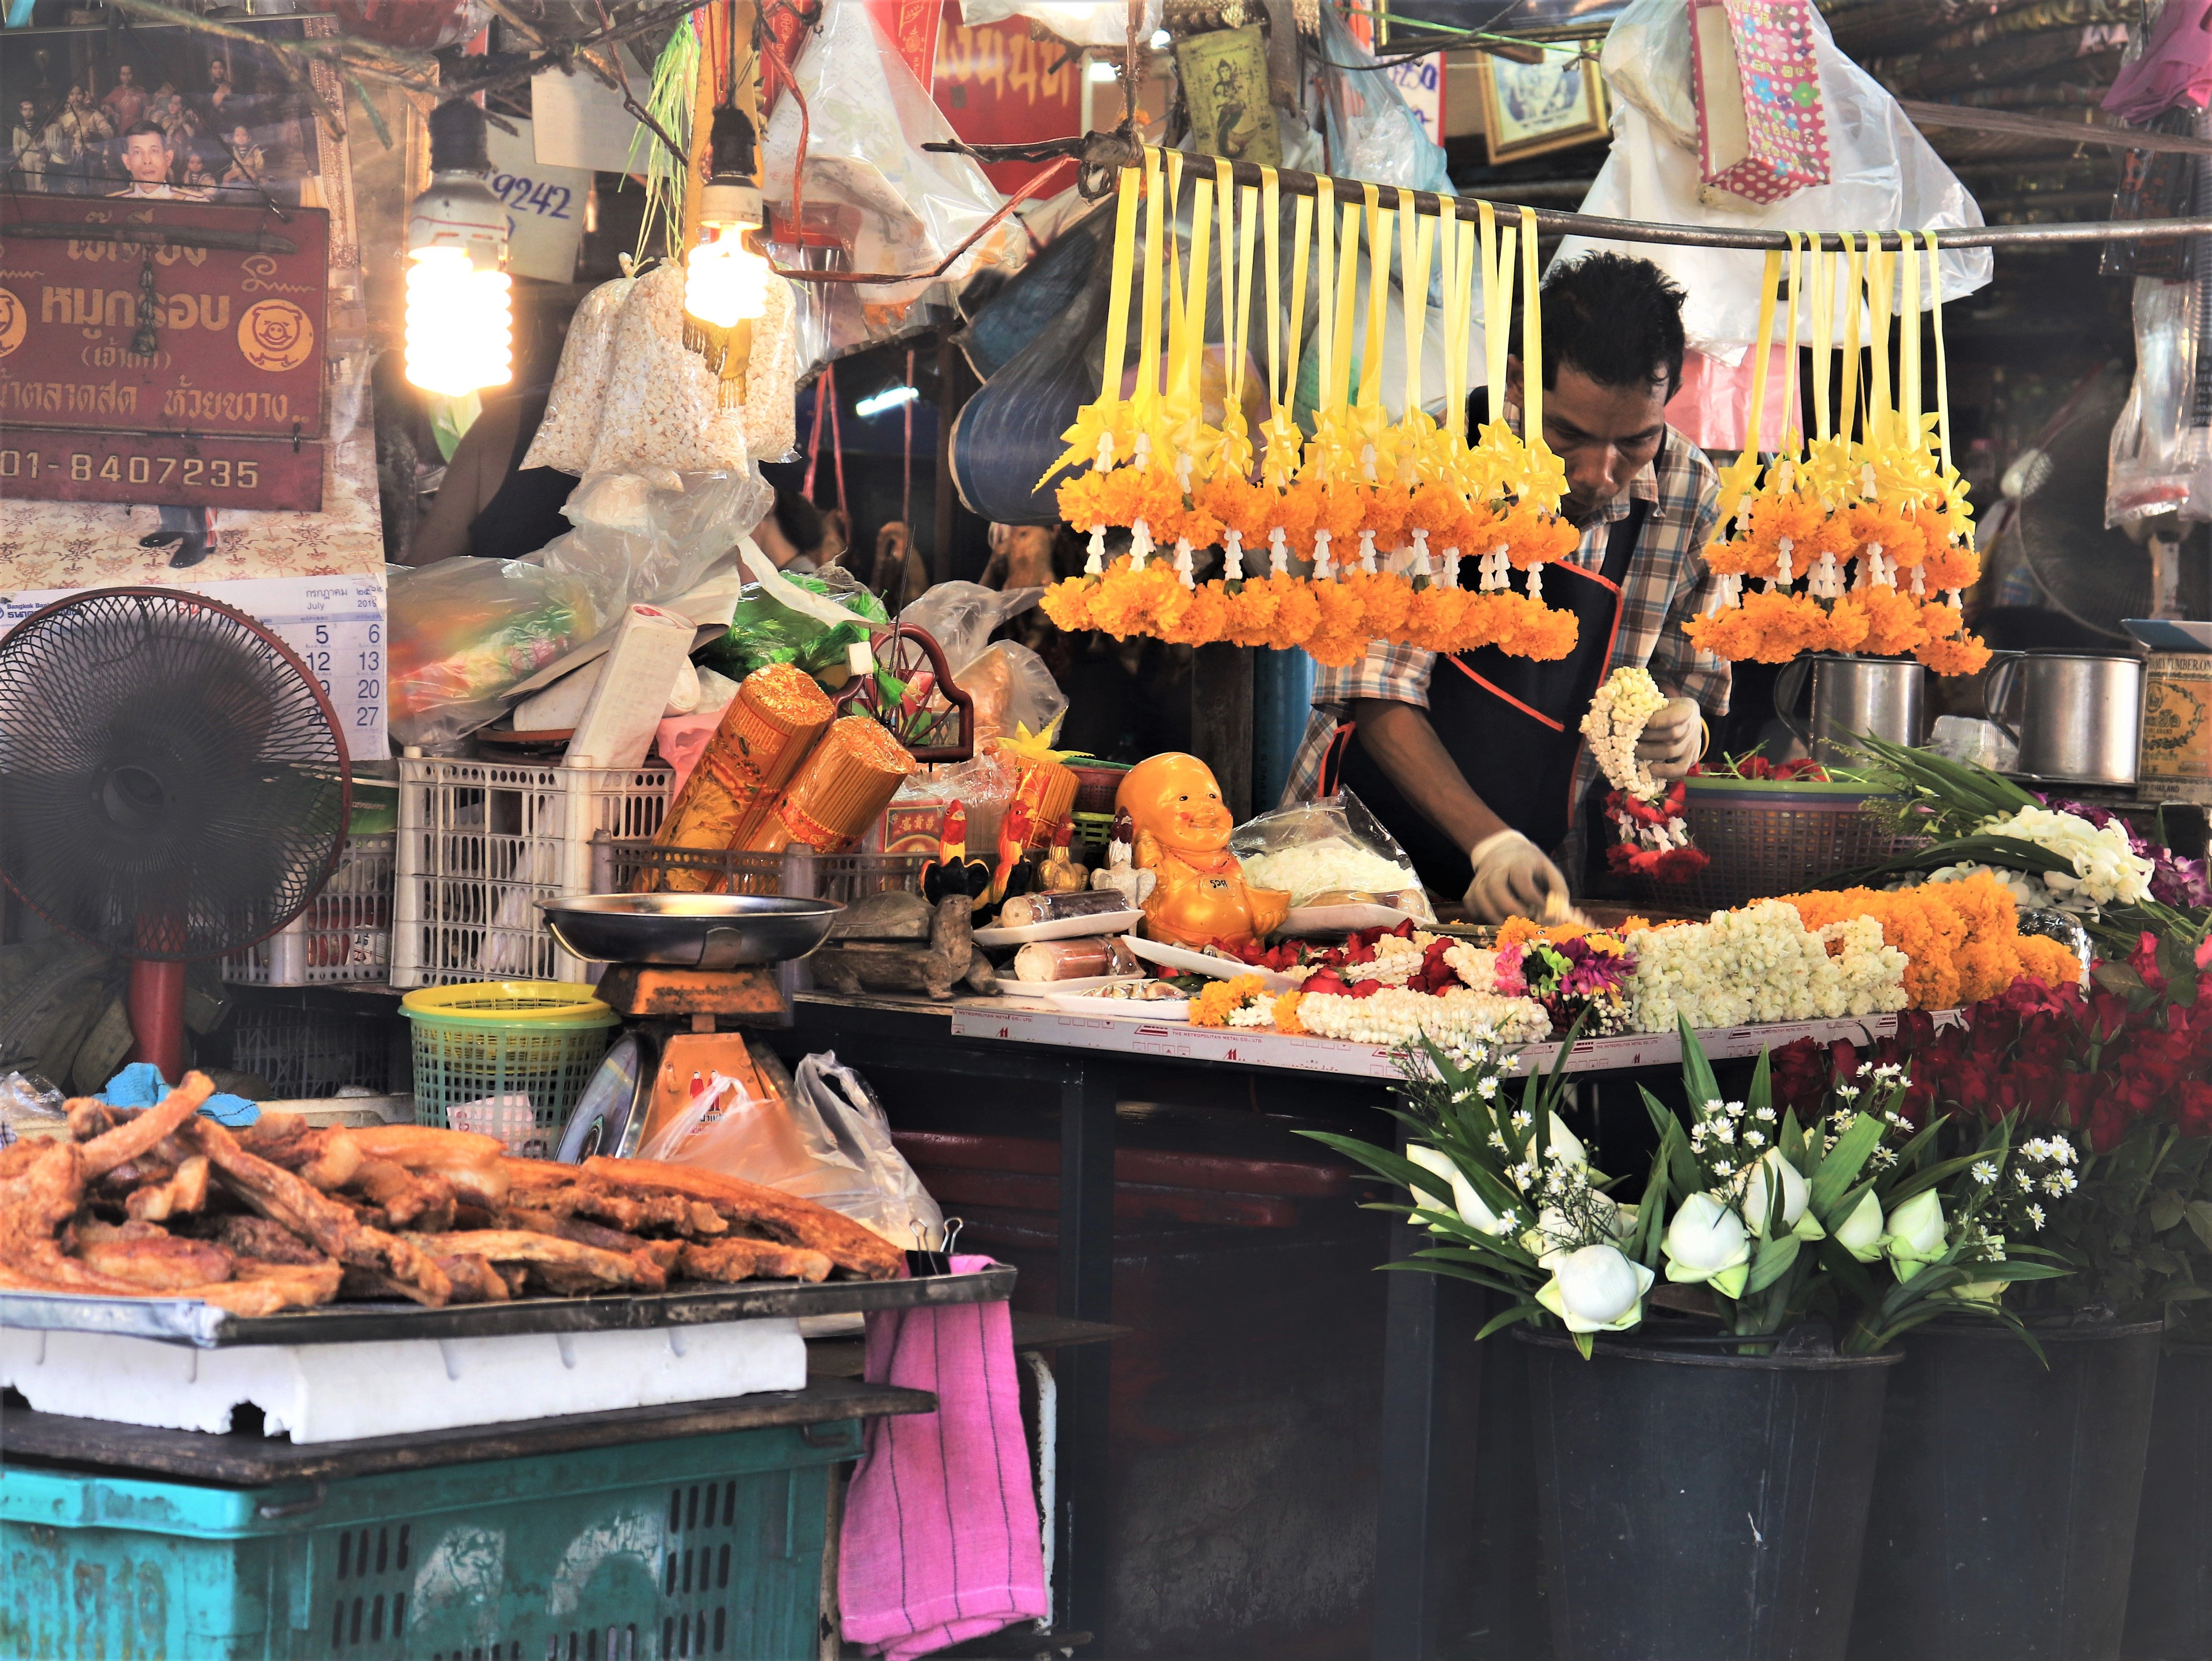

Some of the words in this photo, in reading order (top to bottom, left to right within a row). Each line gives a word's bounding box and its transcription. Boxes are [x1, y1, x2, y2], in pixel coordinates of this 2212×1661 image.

[42, 286, 230, 339] หมูกรอบ
[0, 450, 259, 490] 01-8407235
[306, 588, 347, 600] กรกฎาคม
[307, 603, 325, 611] July
[316, 625, 329, 644] 5
[369, 624, 380, 644] 6
[306, 652, 330, 671] 12
[359, 651, 379, 671] 13
[319, 679, 330, 697] 9
[358, 679, 379, 698] 20
[357, 707, 379, 726] 27
